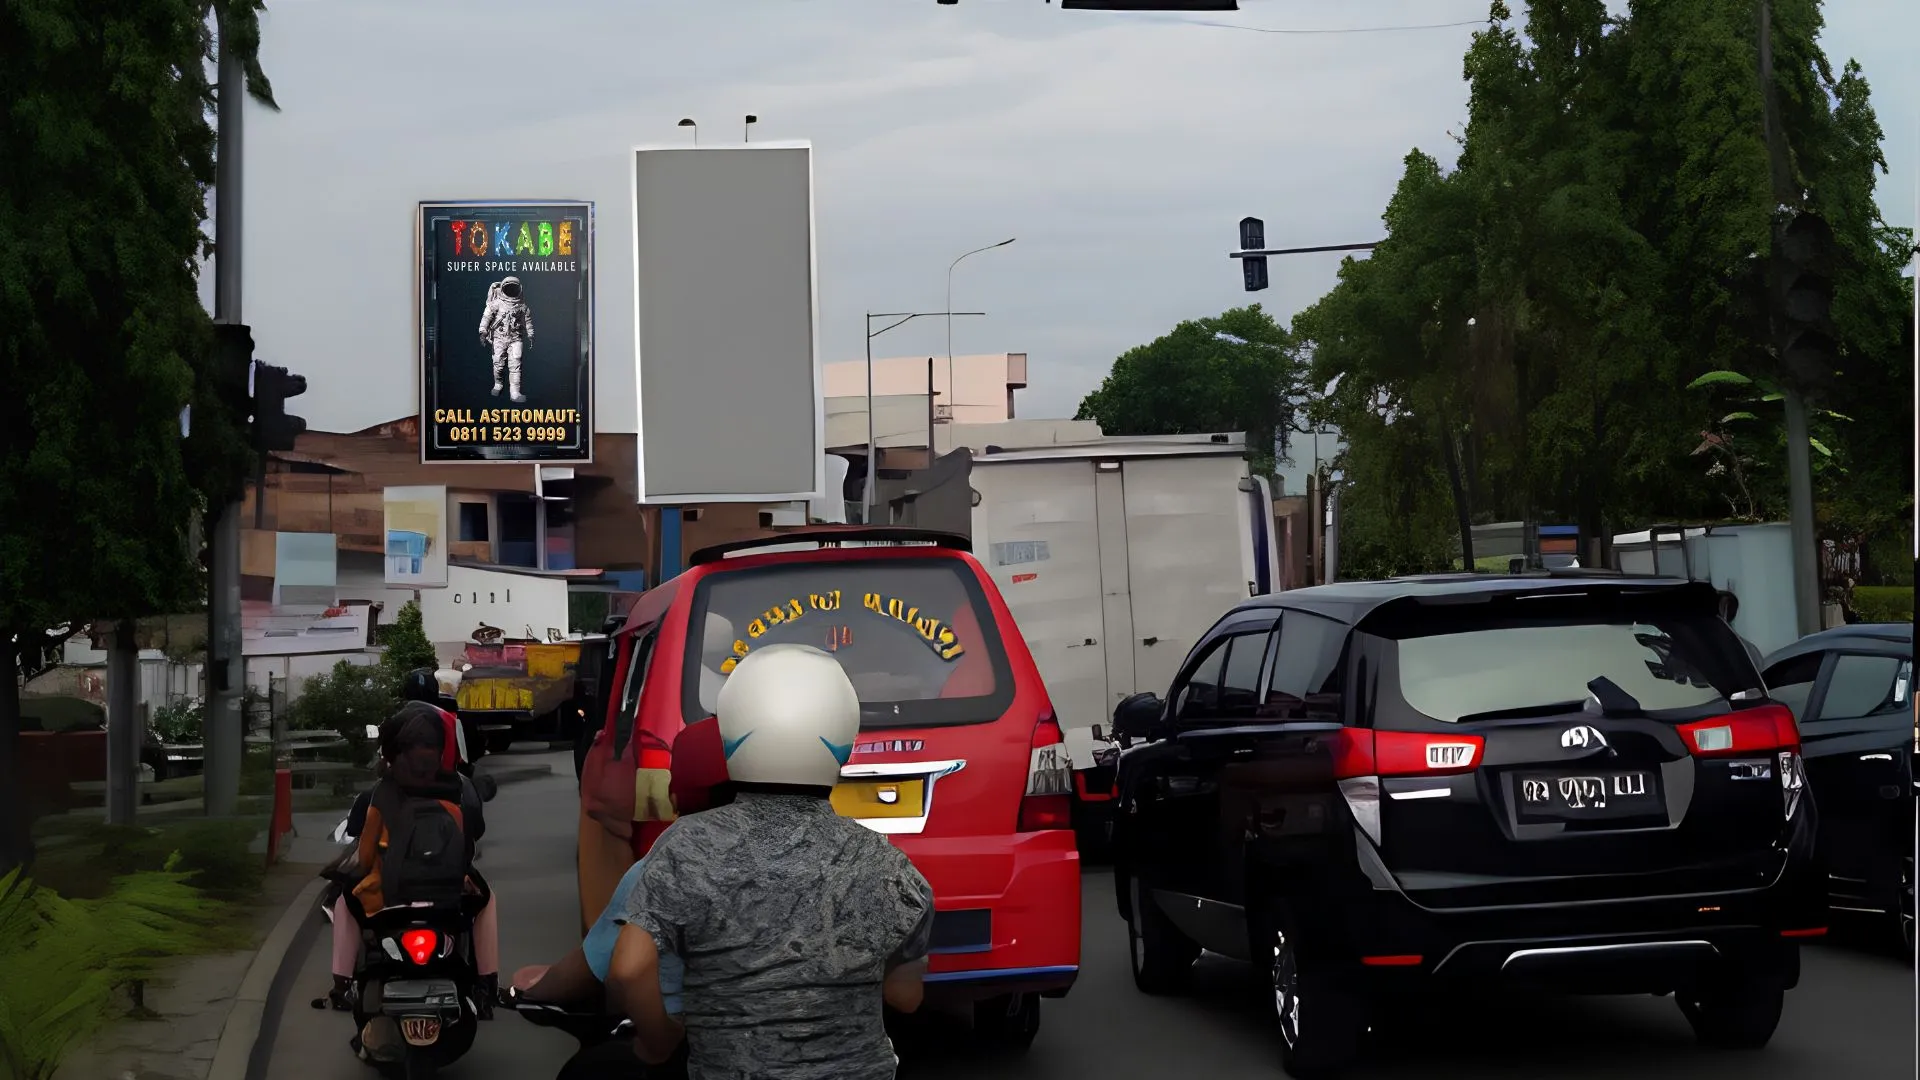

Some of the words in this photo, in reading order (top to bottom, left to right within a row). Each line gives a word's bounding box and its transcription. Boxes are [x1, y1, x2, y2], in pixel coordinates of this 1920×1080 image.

[451, 220, 573, 256] TOKABE
[447, 261, 480, 272] SUPER
[485, 261, 517, 272] SPACE
[522, 261, 576, 272] AVAILABLE
[434, 408, 474, 424] CALL
[480, 408, 581, 424] ASTRONAUT:
[450, 427, 487, 442] 0811
[492, 427, 522, 442] 523
[526, 427, 566, 442] 9999
